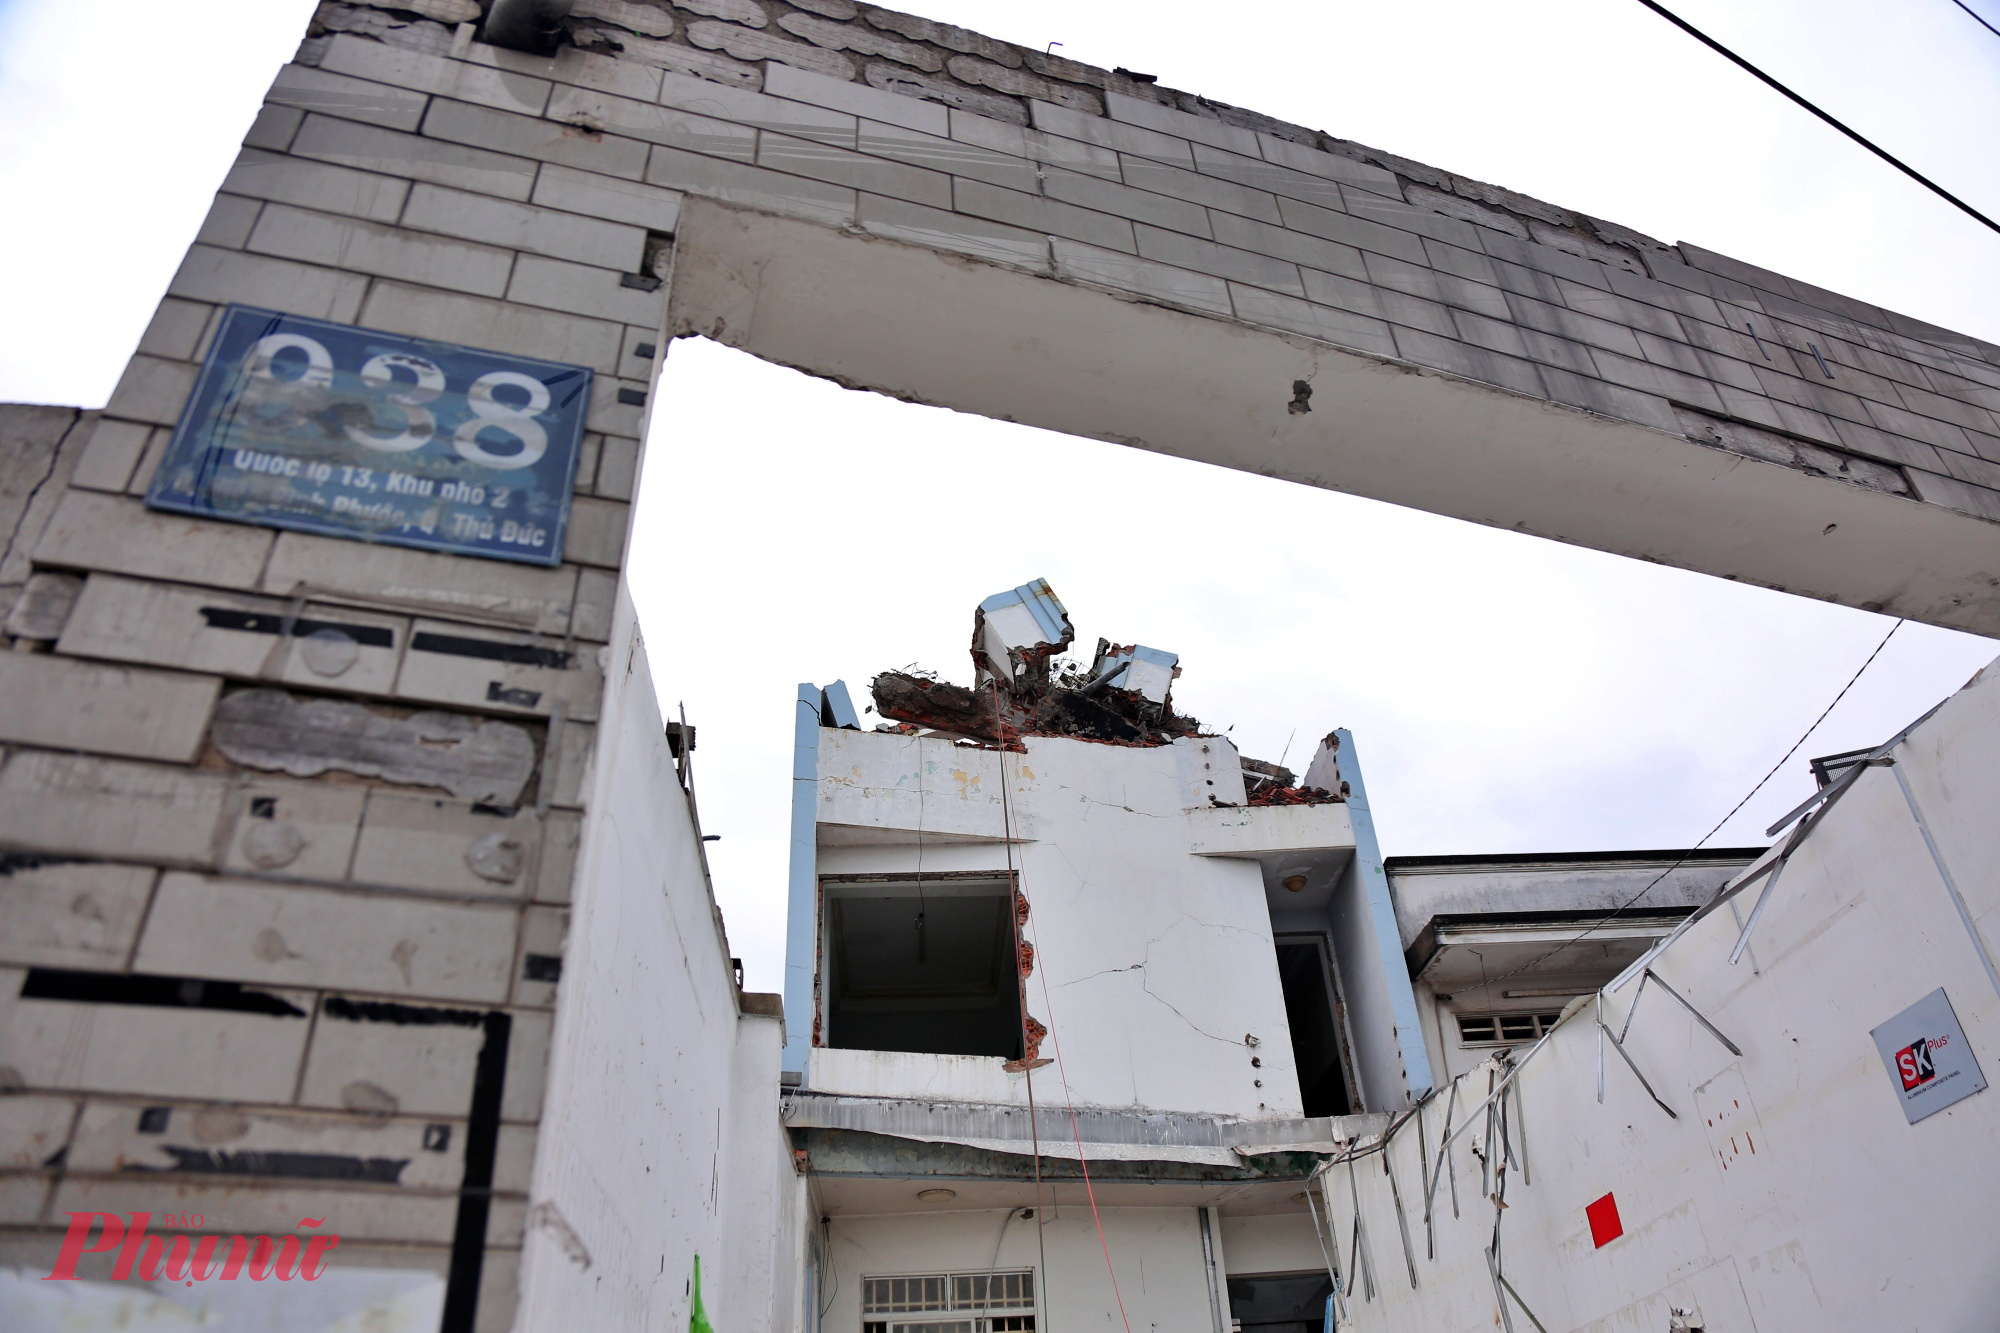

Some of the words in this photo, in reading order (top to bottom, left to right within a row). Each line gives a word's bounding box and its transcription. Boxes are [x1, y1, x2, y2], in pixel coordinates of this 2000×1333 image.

[341, 465, 377, 493] 13,
[385, 471, 435, 497] Khu
[490, 486, 511, 509] 2
[1899, 1043, 1933, 1081] SK
[1927, 1075, 1949, 1091] COMPOSITE
[1948, 1069, 1961, 1080] PANEL
